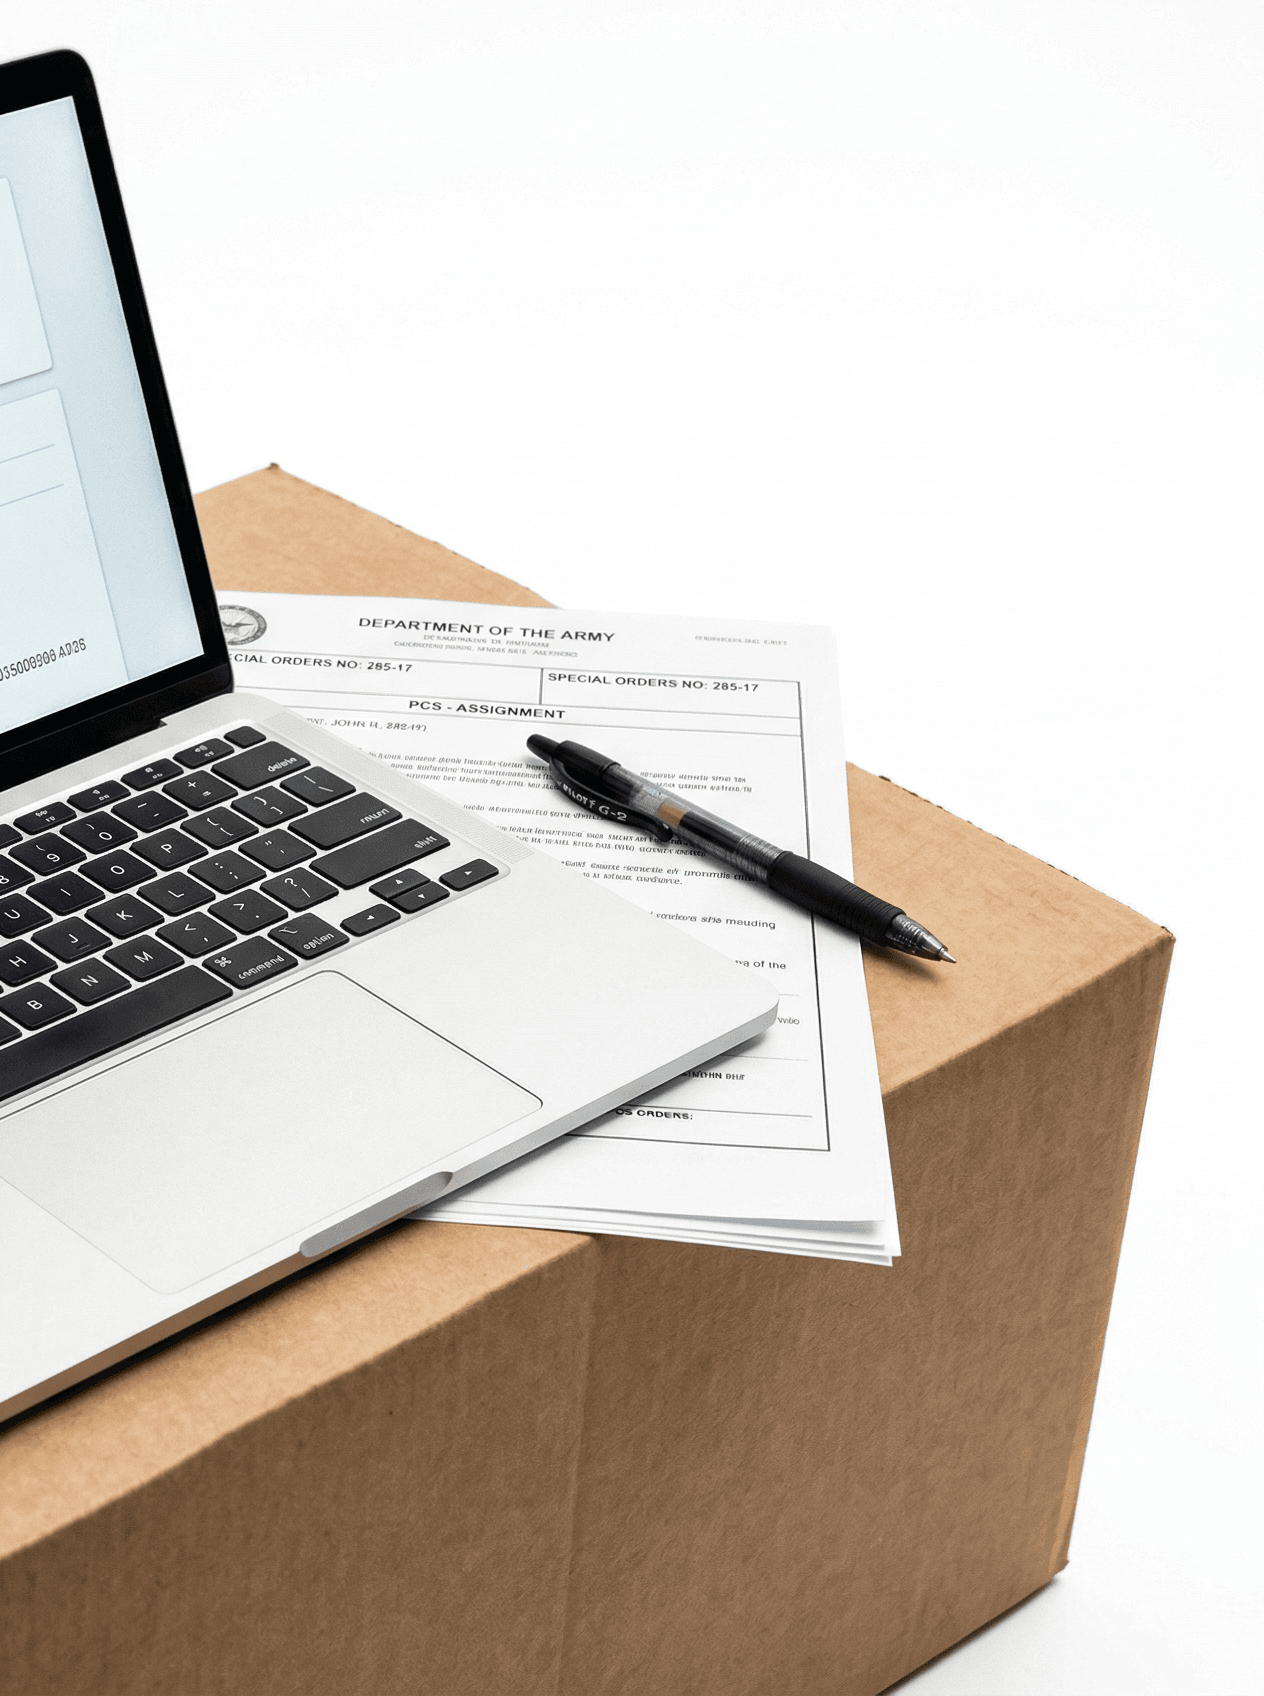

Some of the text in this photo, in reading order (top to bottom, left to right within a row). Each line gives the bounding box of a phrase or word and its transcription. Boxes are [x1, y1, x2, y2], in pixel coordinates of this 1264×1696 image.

[359, 618, 483, 633] DEPARTMENT
[489, 627, 512, 635] OF
[520, 628, 554, 638] THE
[561, 631, 614, 641] ARMY
[272, 657, 331, 666] ORDERS
[337, 659, 363, 670] NO:
[367, 662, 412, 672] 285-17
[548, 673, 758, 691] SPECIAL ORDERS NO: 285-17
[408, 700, 442, 711] PCS
[456, 702, 565, 719] ASSIGNMENT
[598, 806, 627, 822] G-2
[161, 844, 172, 853] P
[47, 854, 60, 862] 9
[5, 910, 20, 918] U
[116, 911, 133, 920] K
[69, 934, 78, 943] J
[9, 956, 26, 967] H
[134, 951, 153, 962] M
[754, 960, 764, 968] of
[81, 975, 98, 986] N
[27, 1000, 42, 1009] B
